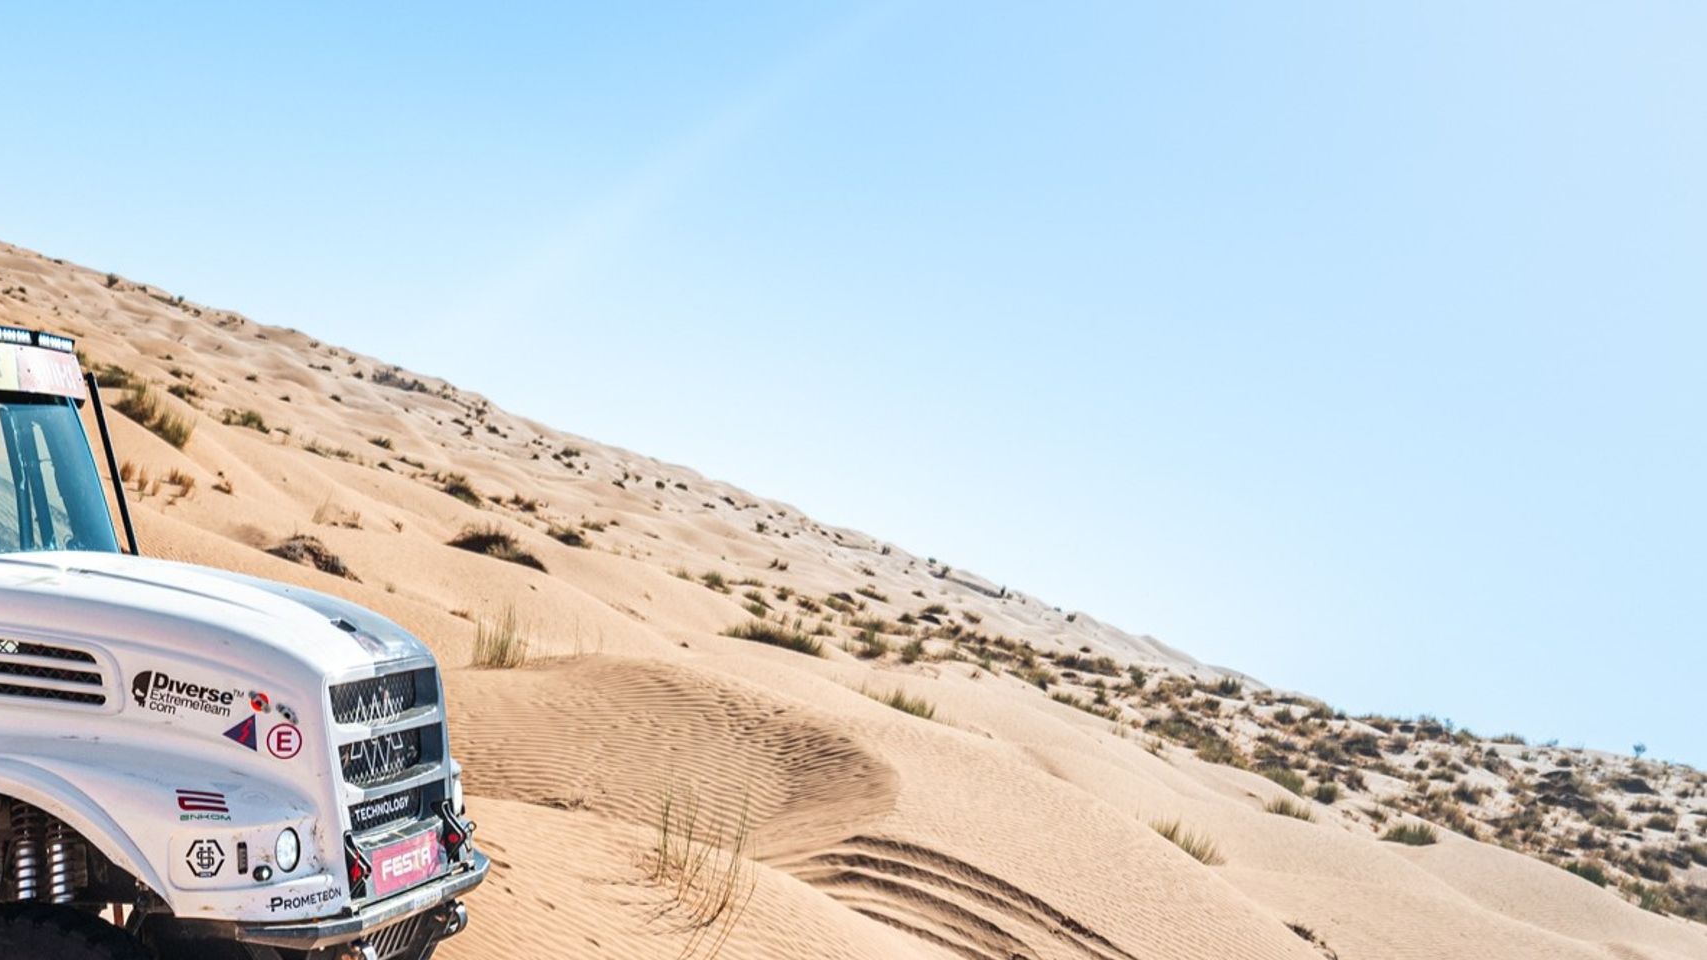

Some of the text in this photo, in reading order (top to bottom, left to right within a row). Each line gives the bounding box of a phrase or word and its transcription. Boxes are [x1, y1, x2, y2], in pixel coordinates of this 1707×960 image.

[153, 672, 233, 705] Diverse
[149, 701, 176, 715] com
[150, 688, 231, 717] ExtremeTeam
[354, 796, 409, 821] TECHNOLOGY
[381, 848, 433, 881] FESTA
[268, 886, 342, 911] PROMETEON
